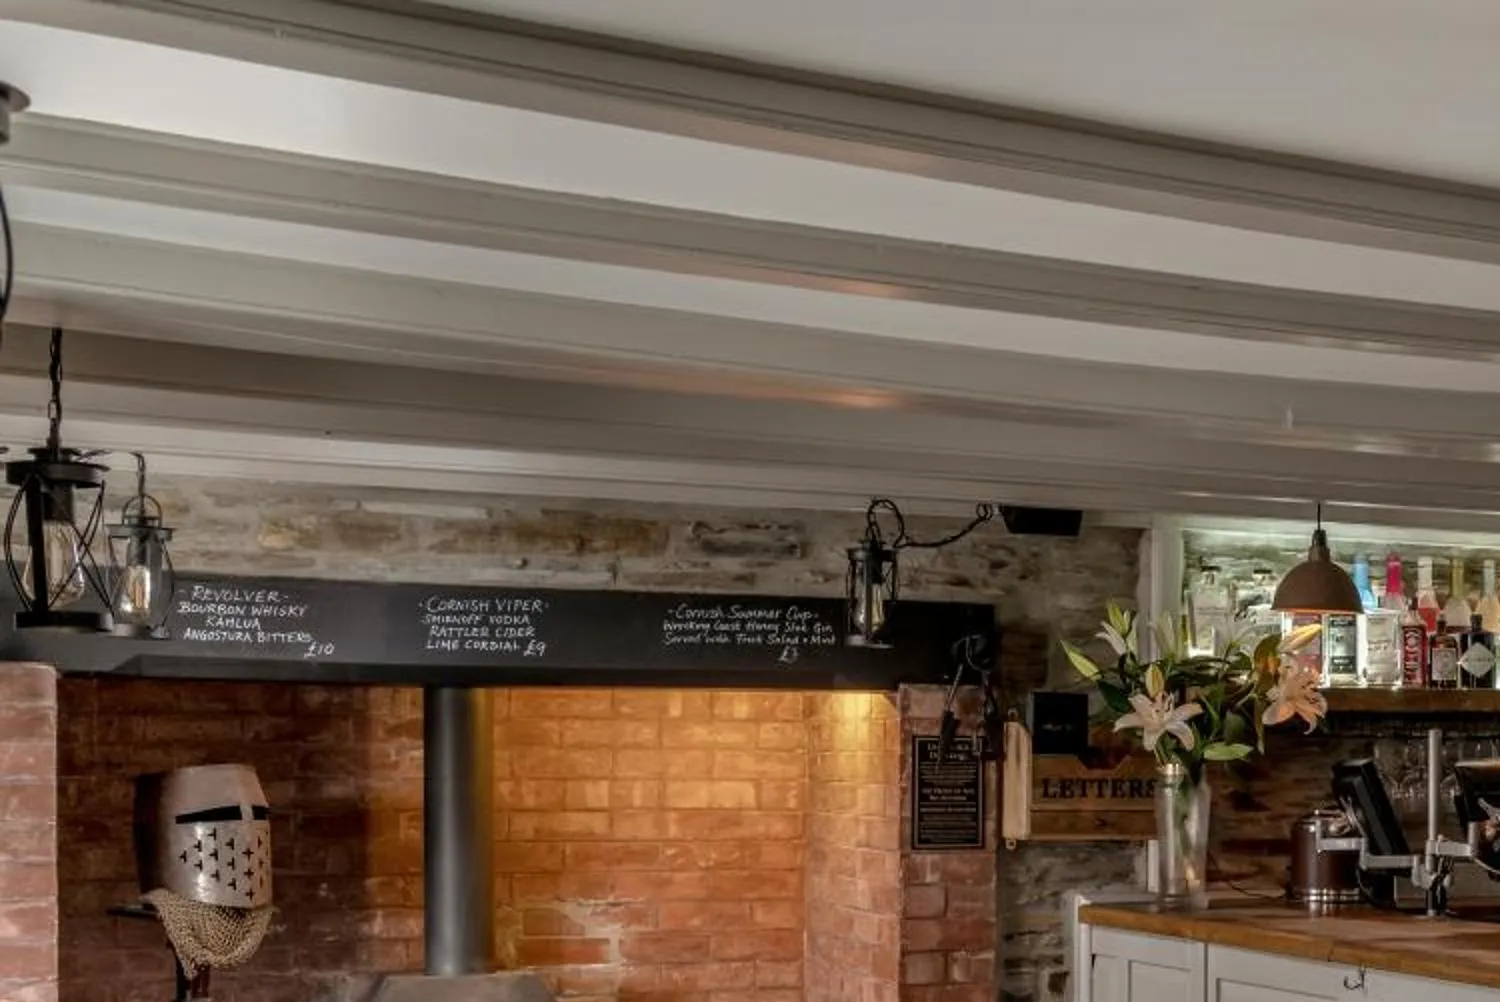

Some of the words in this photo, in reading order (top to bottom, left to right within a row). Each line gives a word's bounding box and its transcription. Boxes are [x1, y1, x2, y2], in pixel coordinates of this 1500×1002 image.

[177, 601, 246, 616] BOURBON
[251, 604, 309, 617] WHISKY
[427, 595, 489, 613] CORNISH
[495, 598, 543, 613] VIPER
[206, 615, 262, 630] KAHLUA
[489, 615, 530, 625] VODKA
[183, 627, 253, 642] ANGOSTURA
[257, 631, 313, 644] BITTERS
[430, 625, 490, 637] RATTLER
[495, 626, 536, 638] CIDER
[303, 642, 335, 658] £10
[464, 640, 521, 652] CORDIAL
[1041, 778, 1155, 800] LETTERS
